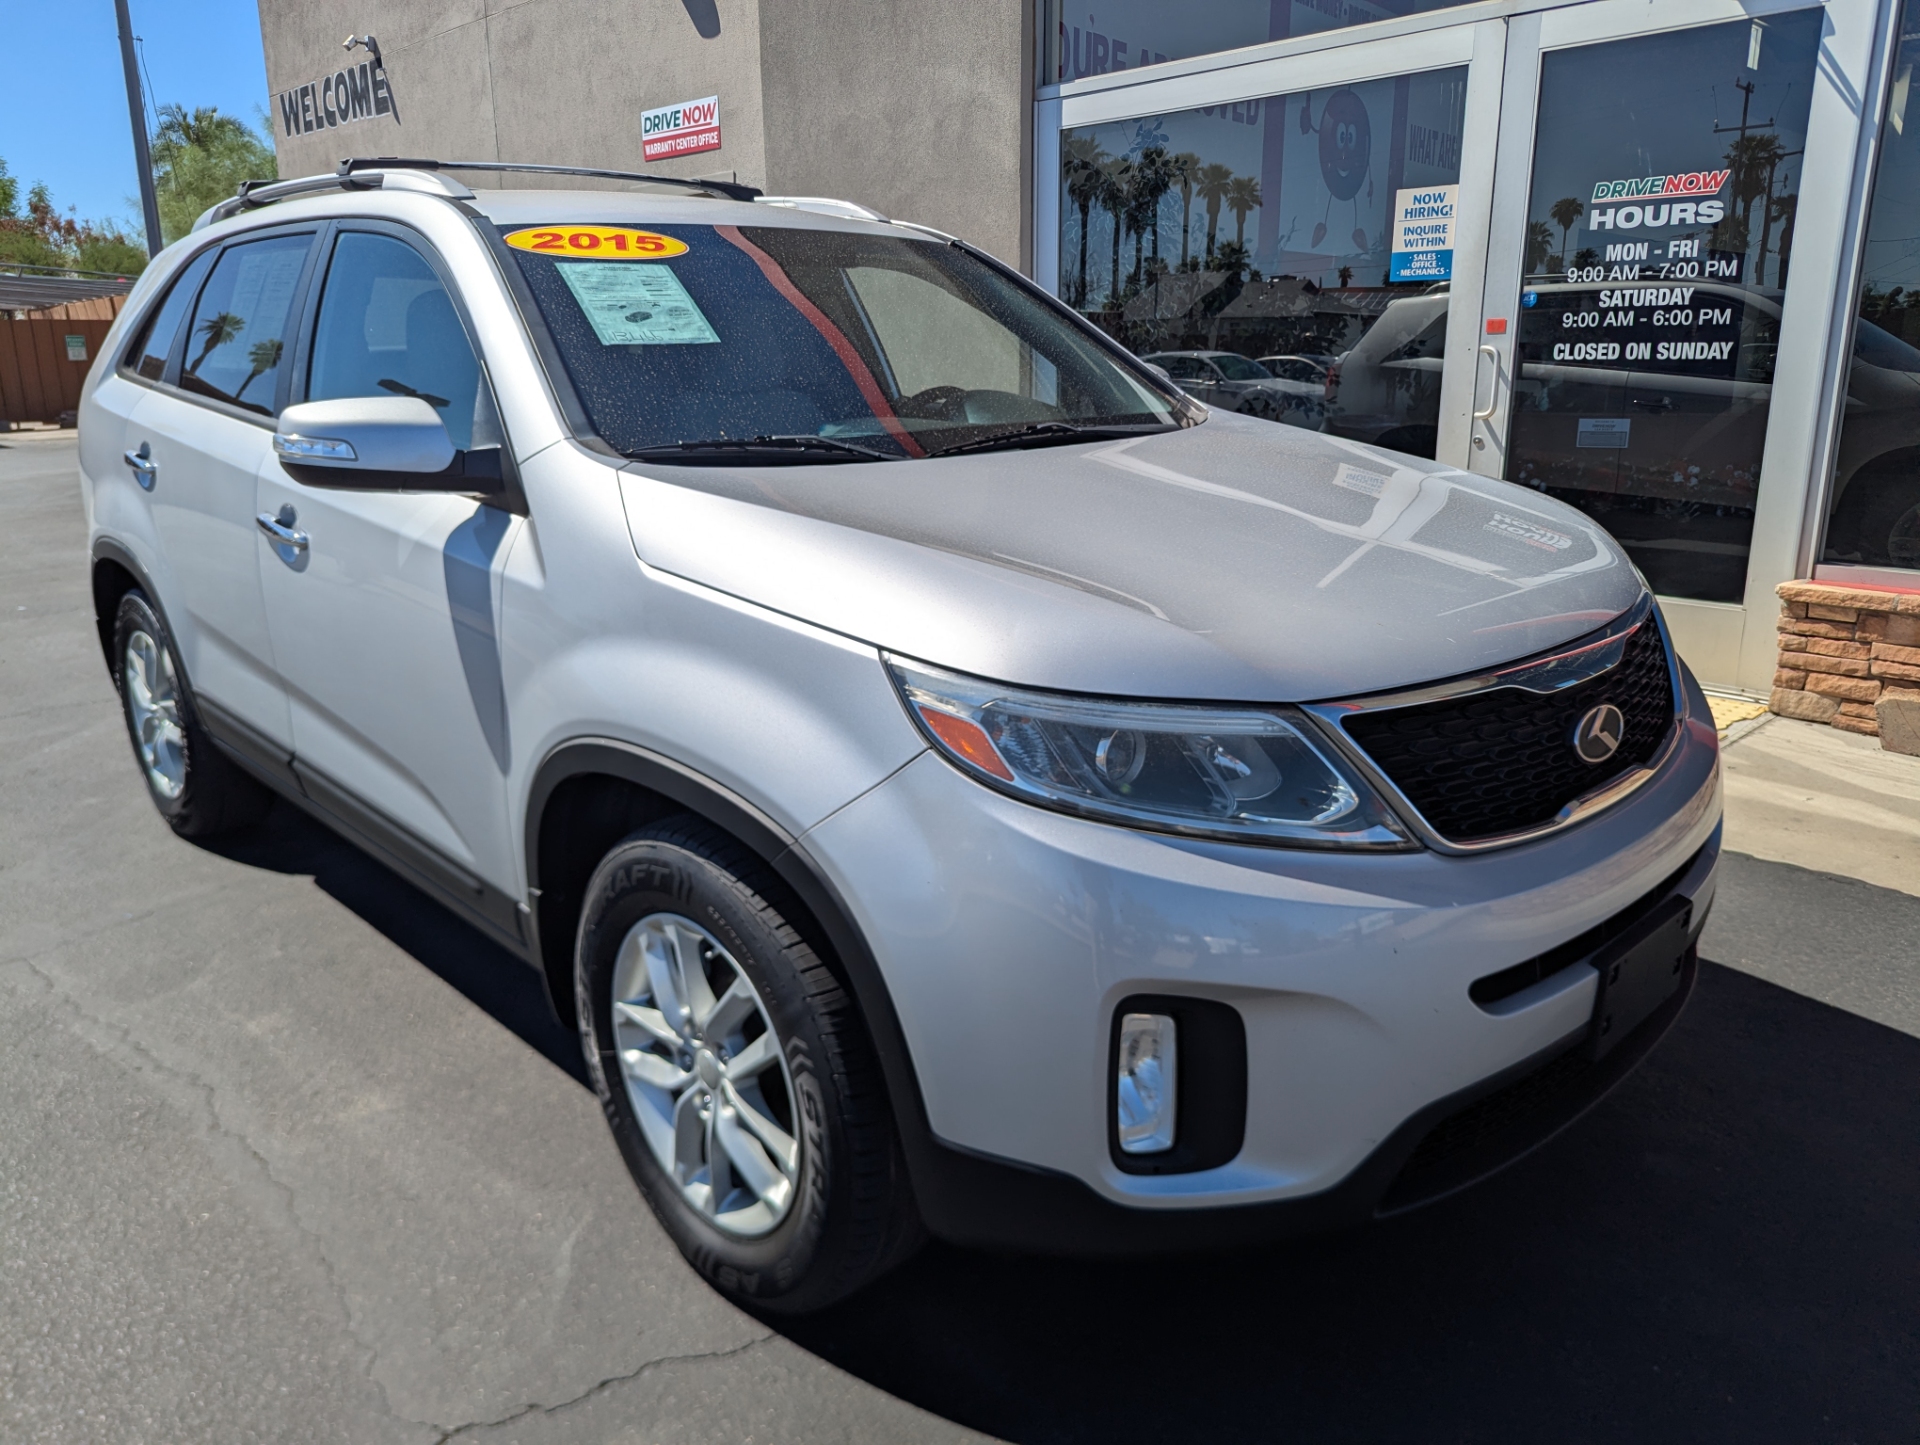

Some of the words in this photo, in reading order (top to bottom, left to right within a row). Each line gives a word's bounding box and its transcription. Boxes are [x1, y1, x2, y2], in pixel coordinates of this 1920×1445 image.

[279, 58, 391, 138] WELCOME
[645, 139, 676, 156] WARRANTY
[676, 135, 698, 150] CENTER
[698, 131, 719, 147] OFFICE
[1410, 124, 1438, 166] WHAT
[1413, 192, 1446, 205] NOW
[1404, 204, 1453, 219] HIRING!
[1589, 200, 1724, 230] HOURS
[1403, 223, 1448, 237] INQUIRE
[531, 232, 667, 252] 2015
[1404, 236, 1446, 248] WITHIN
[1605, 242, 1648, 262] MON
[1668, 239, 1699, 259] FRI
[1411, 260, 1437, 269] OFFICE
[1413, 253, 1436, 261] SALES
[1400, 267, 1445, 277] MECHANICS
[1567, 267, 1604, 283] 9:00
[1608, 264, 1640, 281] AM
[1659, 262, 1699, 279] 7:00
[1704, 260, 1738, 277] PM
[1599, 288, 1695, 308] SATURDAY
[1562, 312, 1599, 328] 9:00
[1603, 311, 1635, 327] AM
[1652, 310, 1693, 326] 6:00
[1698, 308, 1732, 325] PM
[1553, 343, 1620, 361] CLOSED
[1625, 343, 1652, 361] ON
[1656, 342, 1734, 360] SUNDAY
